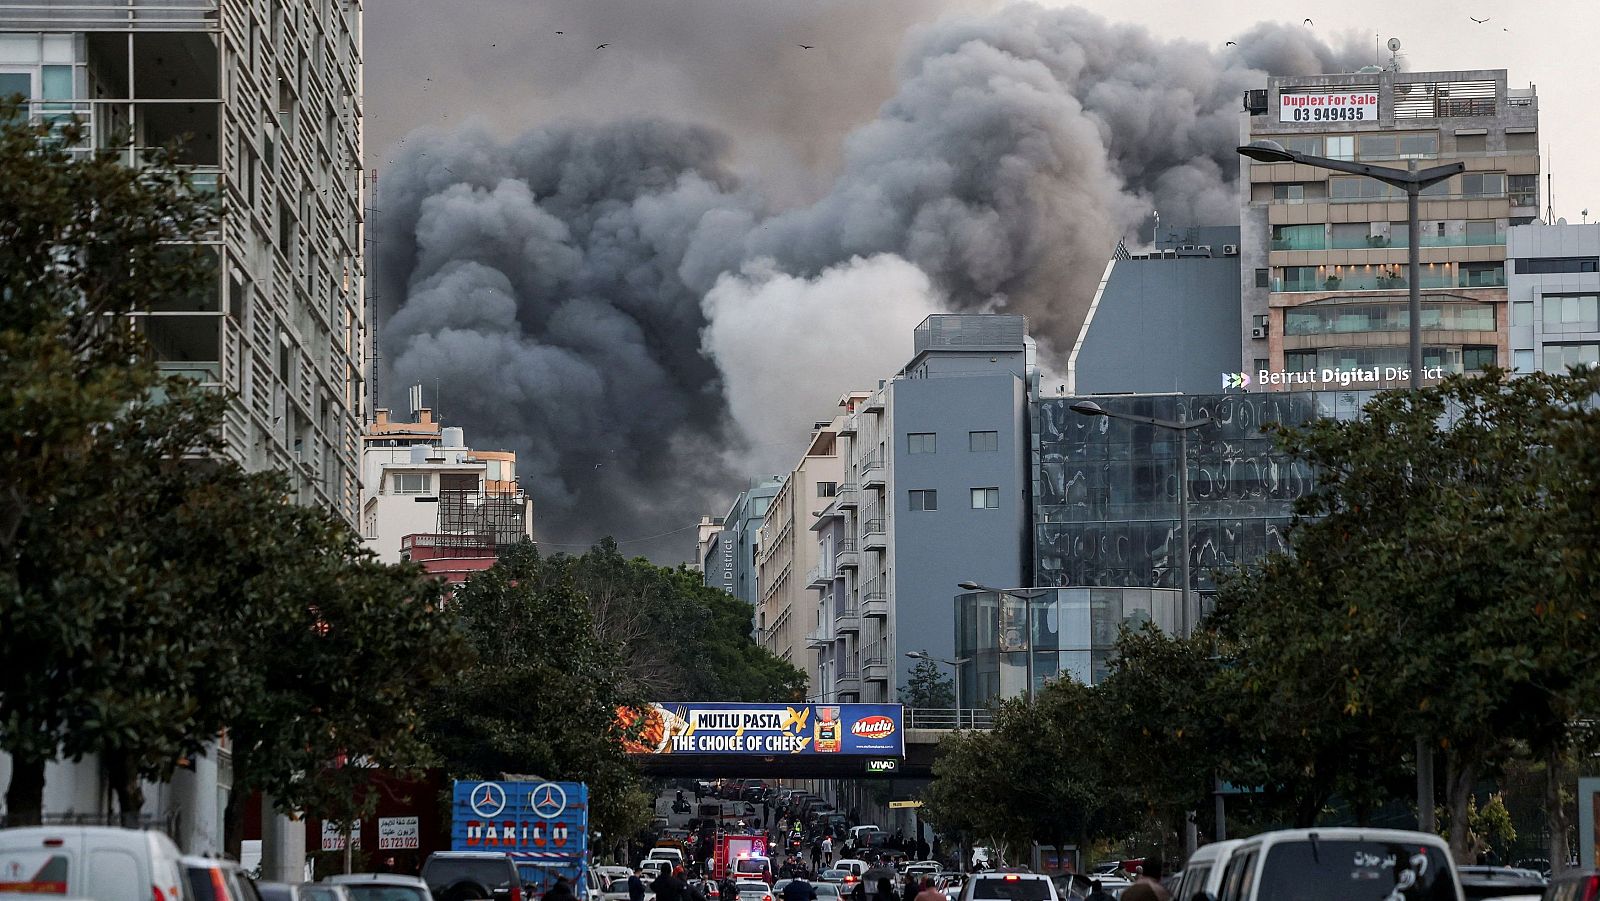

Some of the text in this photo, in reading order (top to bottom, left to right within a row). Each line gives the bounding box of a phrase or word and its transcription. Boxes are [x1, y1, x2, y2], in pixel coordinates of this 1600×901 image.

[1283, 93, 1377, 108] Duplex For Sale
[1293, 107, 1364, 121] 03 949435
[1259, 368, 1316, 384] Beirut
[1321, 367, 1381, 385] Digital
[723, 539, 733, 579] District
[698, 713, 782, 729] MUTLU PASTA
[851, 719, 892, 734] Mutlu
[671, 735, 696, 751] THE
[698, 735, 744, 751] CHOICE
[746, 735, 763, 751] OF
[765, 735, 804, 751] CHEFS
[323, 838, 332, 848] 03
[380, 837, 418, 848] 03 723 022
